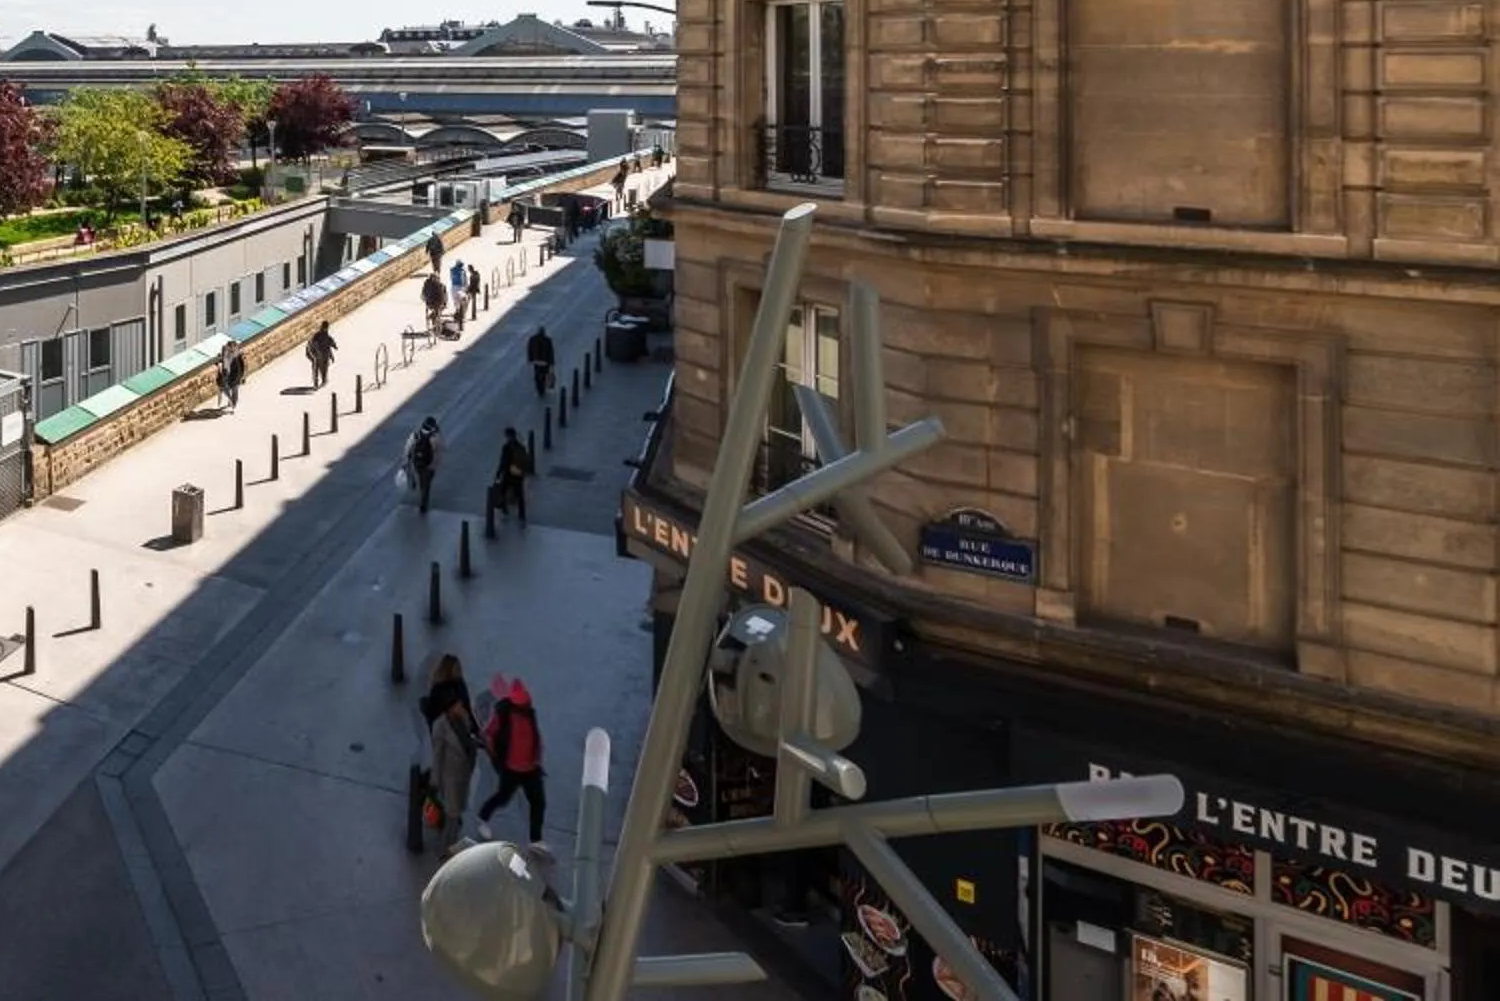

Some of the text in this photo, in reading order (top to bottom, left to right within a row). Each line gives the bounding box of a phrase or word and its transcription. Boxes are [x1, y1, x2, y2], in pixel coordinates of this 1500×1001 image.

[945, 550, 1029, 574] DUNKERQUE
[959, 539, 990, 553] RUE
[633, 505, 860, 652] L'ENE DUX
[1196, 791, 1378, 869] L'ENTRE
